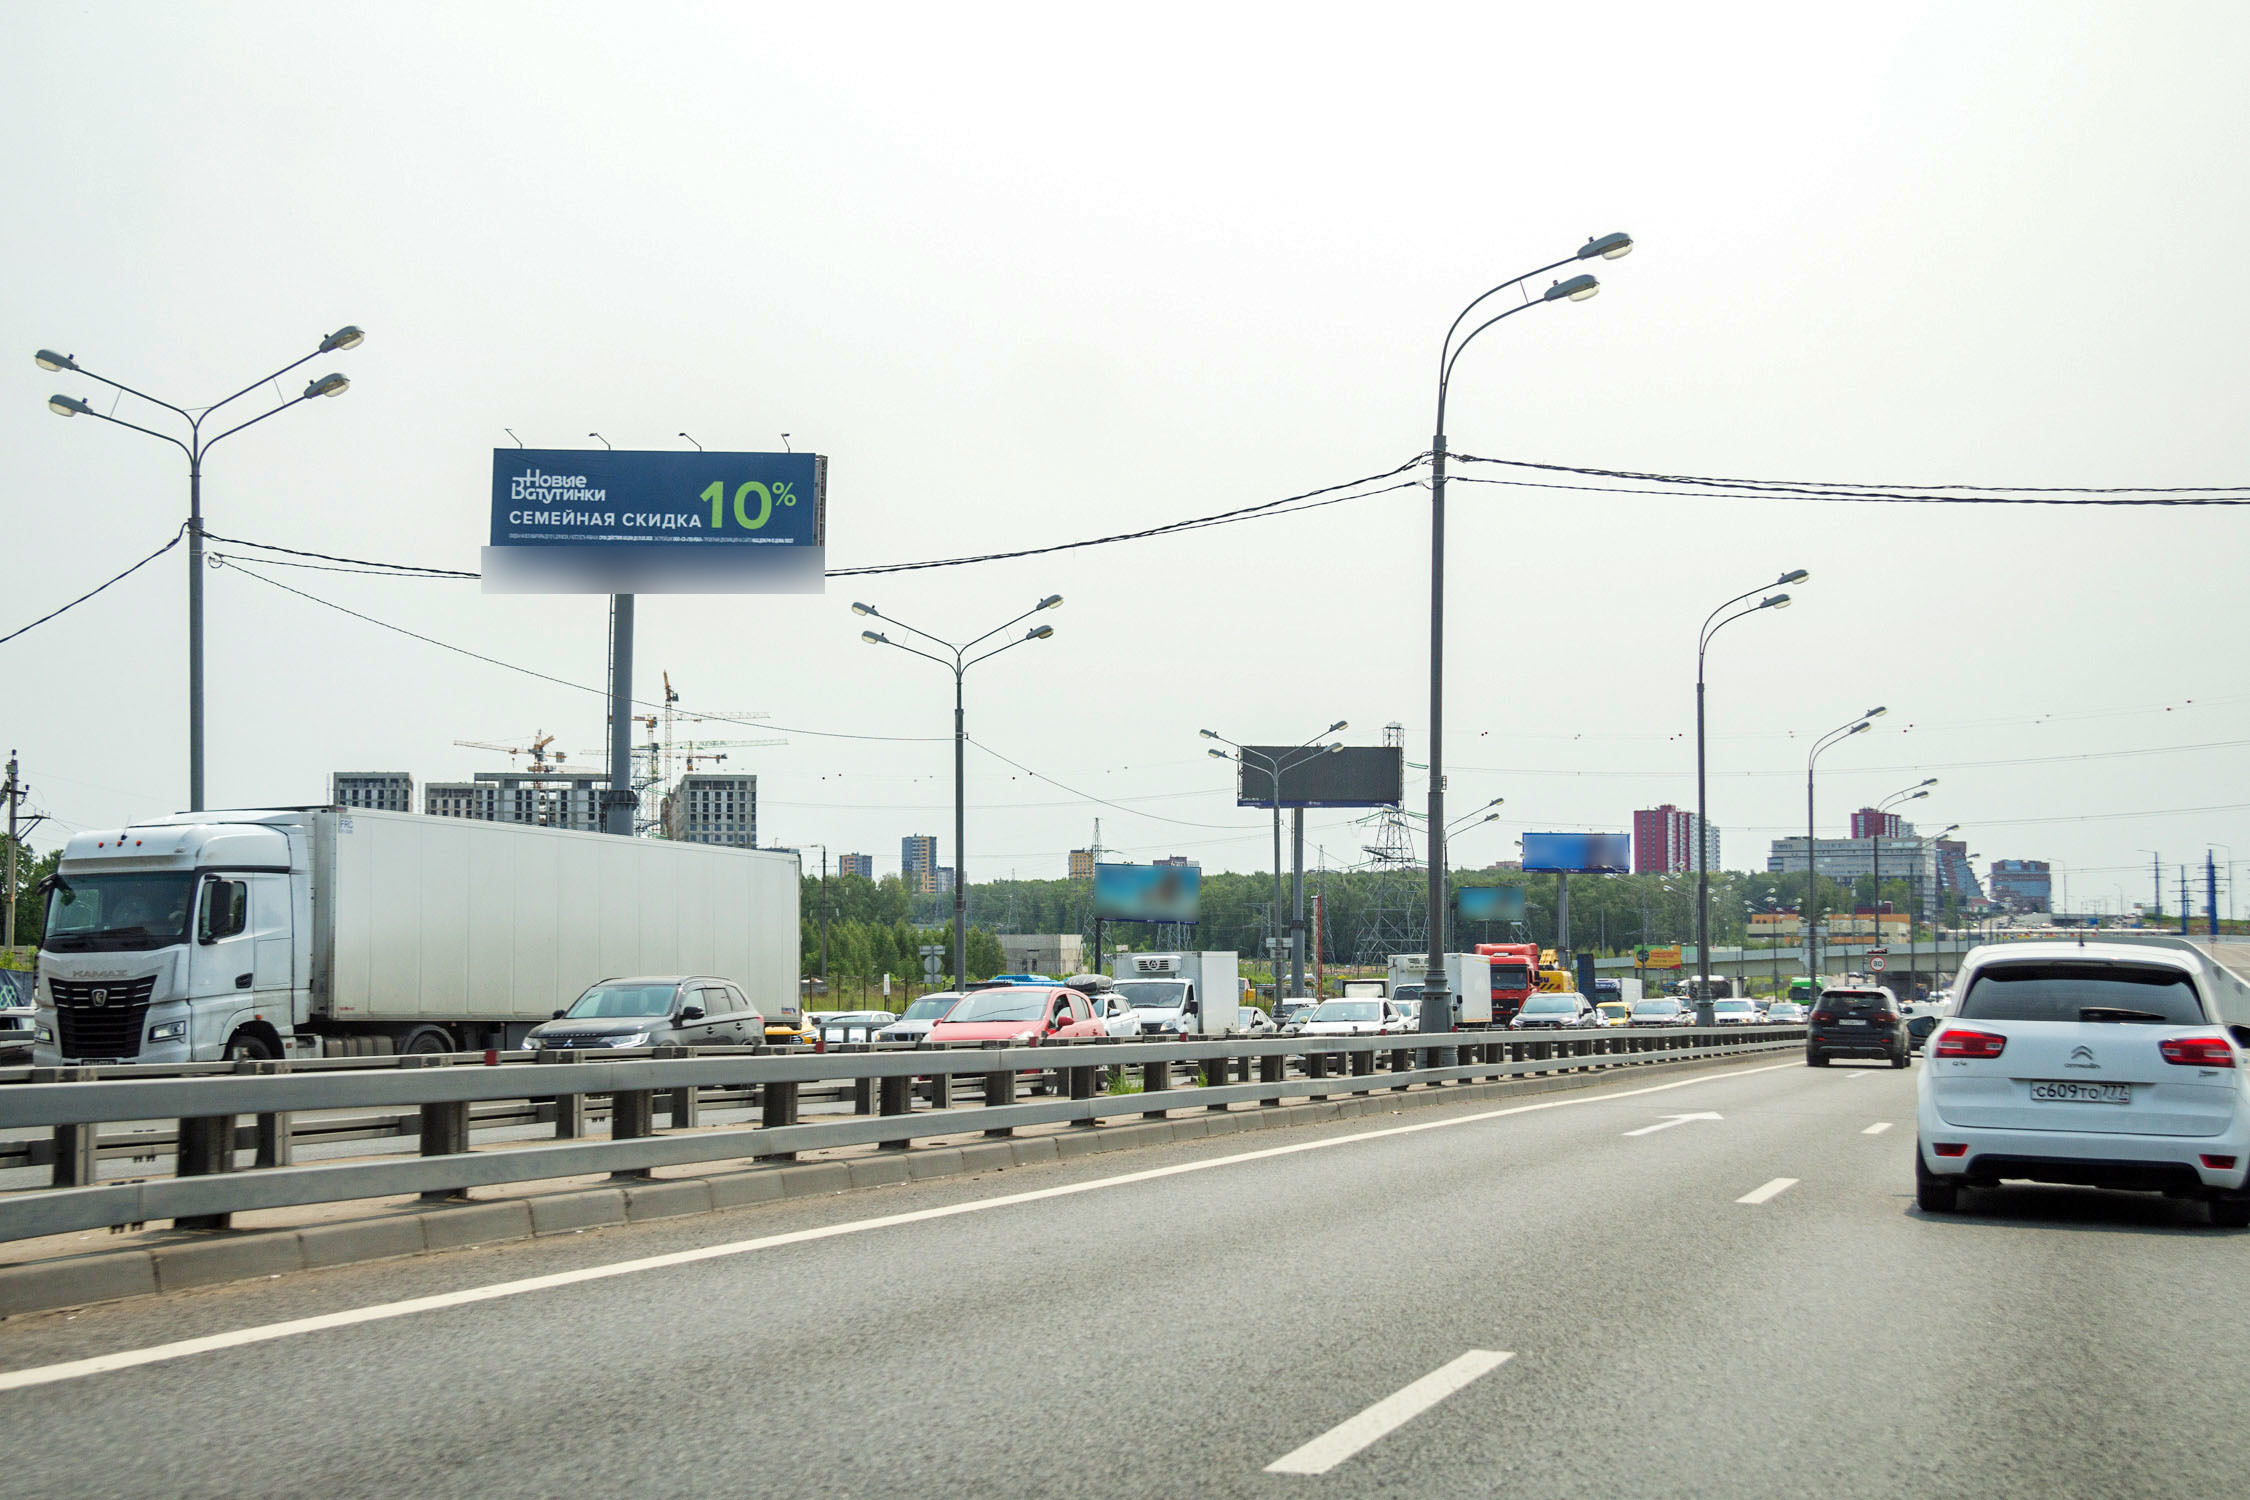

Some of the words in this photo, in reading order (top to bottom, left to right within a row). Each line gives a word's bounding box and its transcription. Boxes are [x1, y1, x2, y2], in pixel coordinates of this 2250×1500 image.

[512, 468, 587, 488] Новые
[511, 478, 606, 504] Ватутинки
[700, 481, 797, 530] 10%
[509, 509, 615, 526] СЕМЕЙНАЯ
[622, 512, 702, 529] СКИДКА
